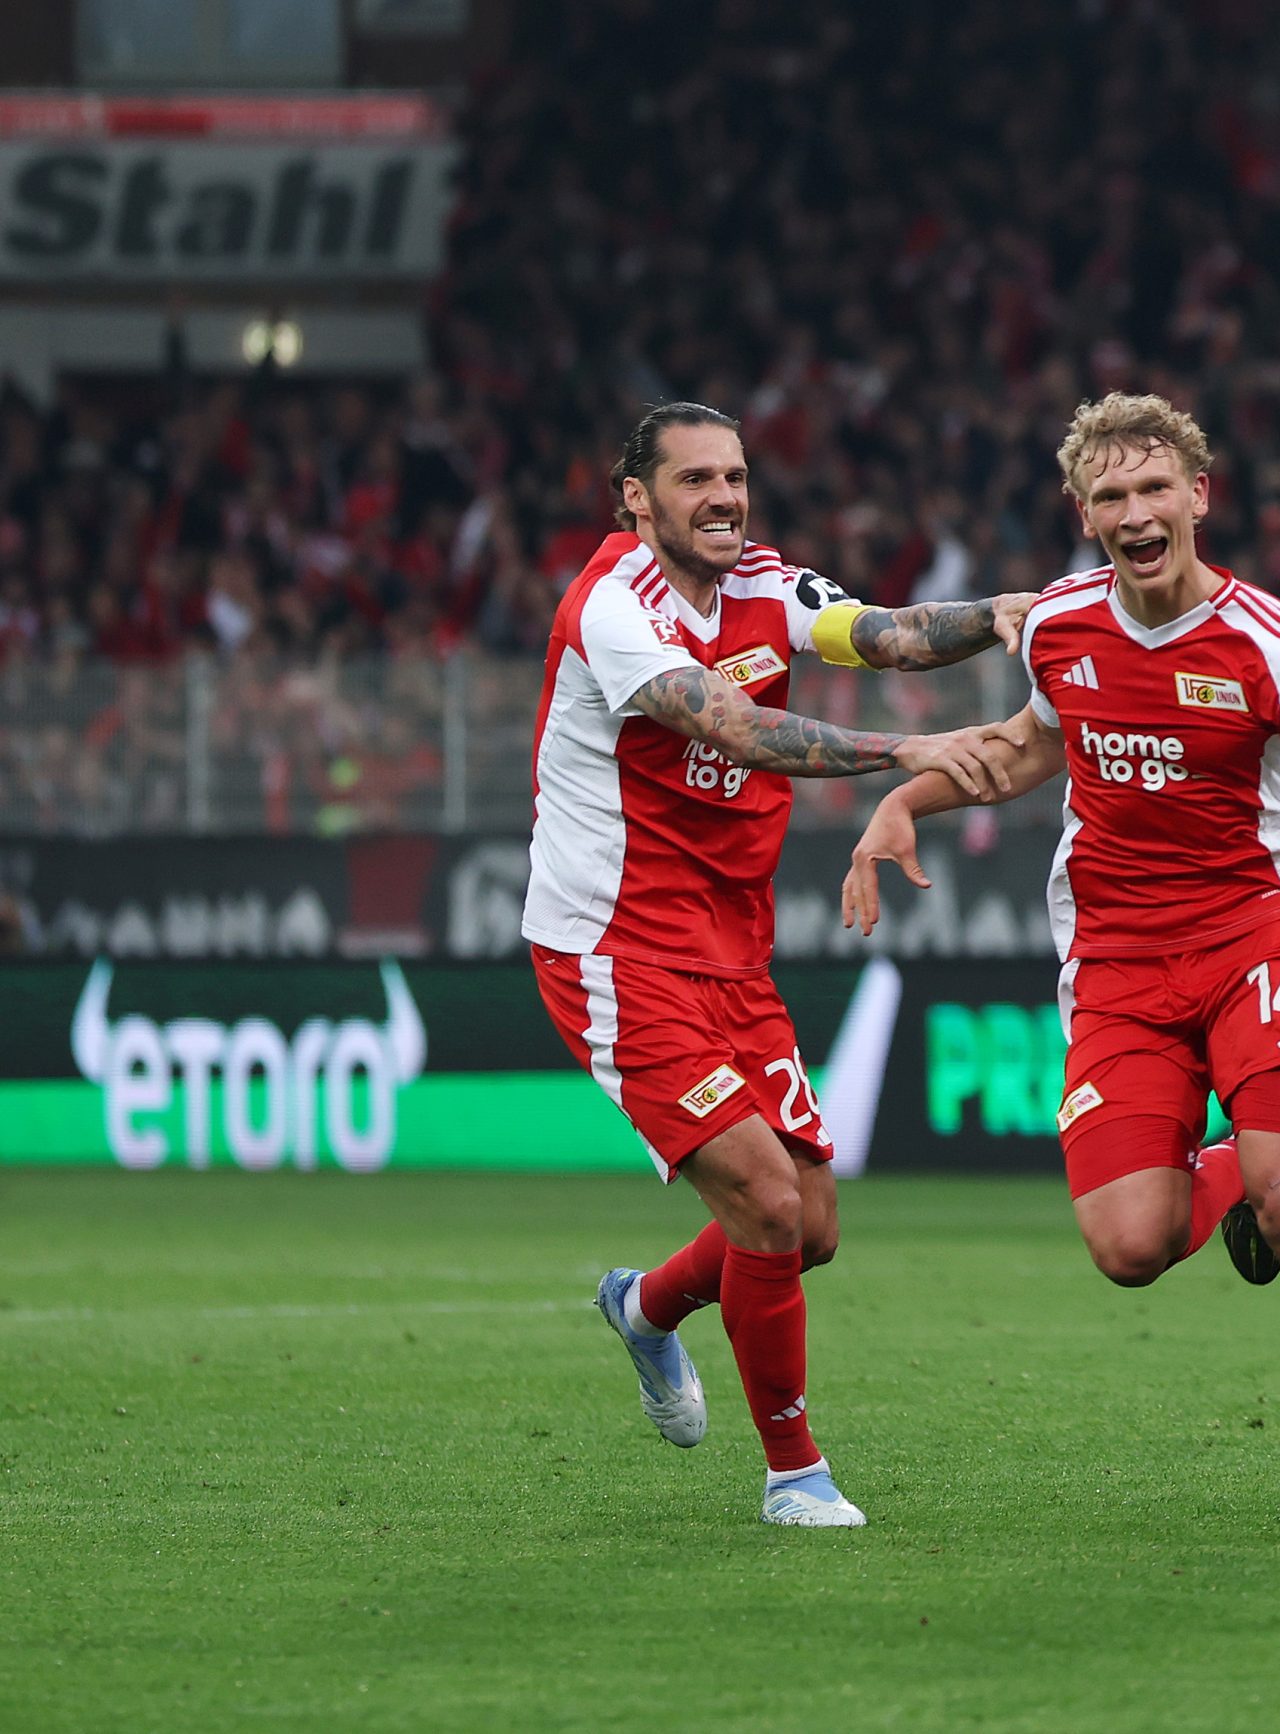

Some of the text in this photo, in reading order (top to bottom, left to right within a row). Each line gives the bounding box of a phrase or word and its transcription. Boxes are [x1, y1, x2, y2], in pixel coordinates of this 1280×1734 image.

[4, 150, 416, 258] Stahl
[748, 657, 778, 674] UNION
[1215, 689, 1242, 705] UNION
[682, 738, 734, 766] ho
[1080, 722, 1185, 761] home
[685, 760, 719, 790] to
[1098, 754, 1134, 783] to
